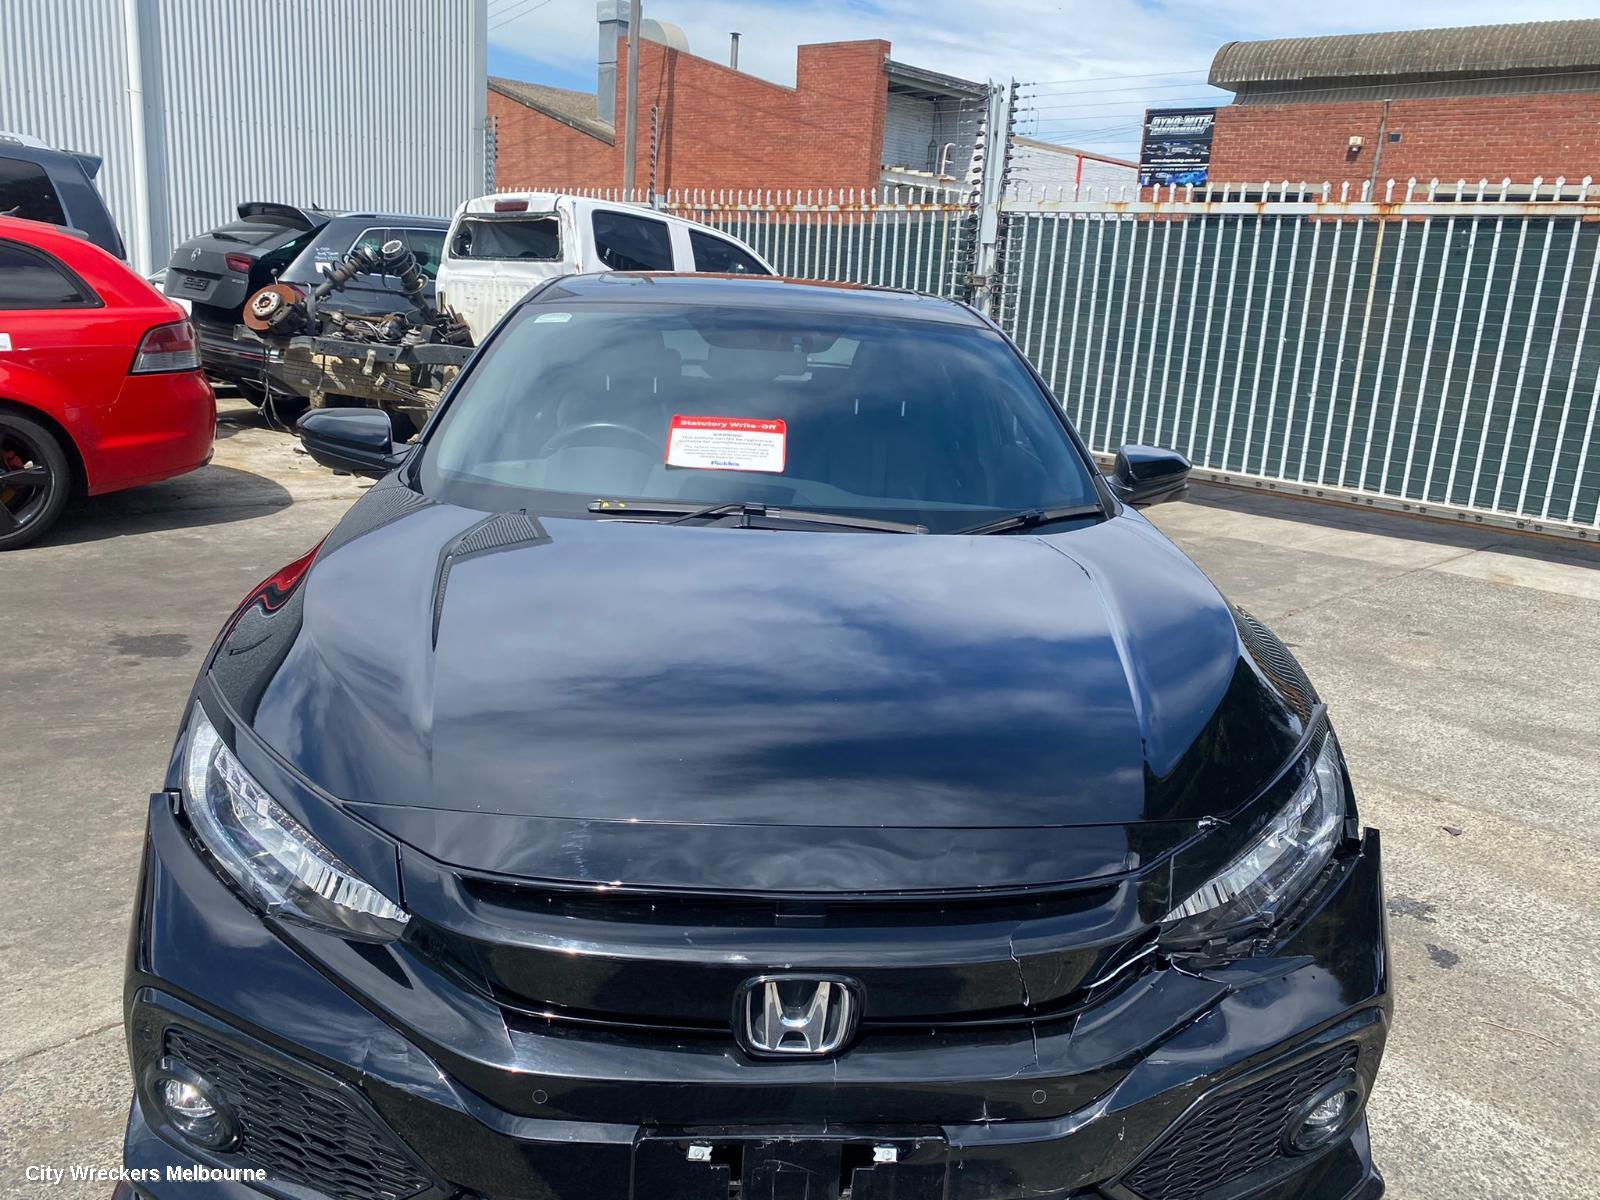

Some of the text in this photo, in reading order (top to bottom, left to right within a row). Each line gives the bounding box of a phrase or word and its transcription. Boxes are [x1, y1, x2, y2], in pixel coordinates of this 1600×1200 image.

[1152, 116, 1212, 127] DYNO-MITE
[680, 420, 777, 430] Statutory Write-Off
